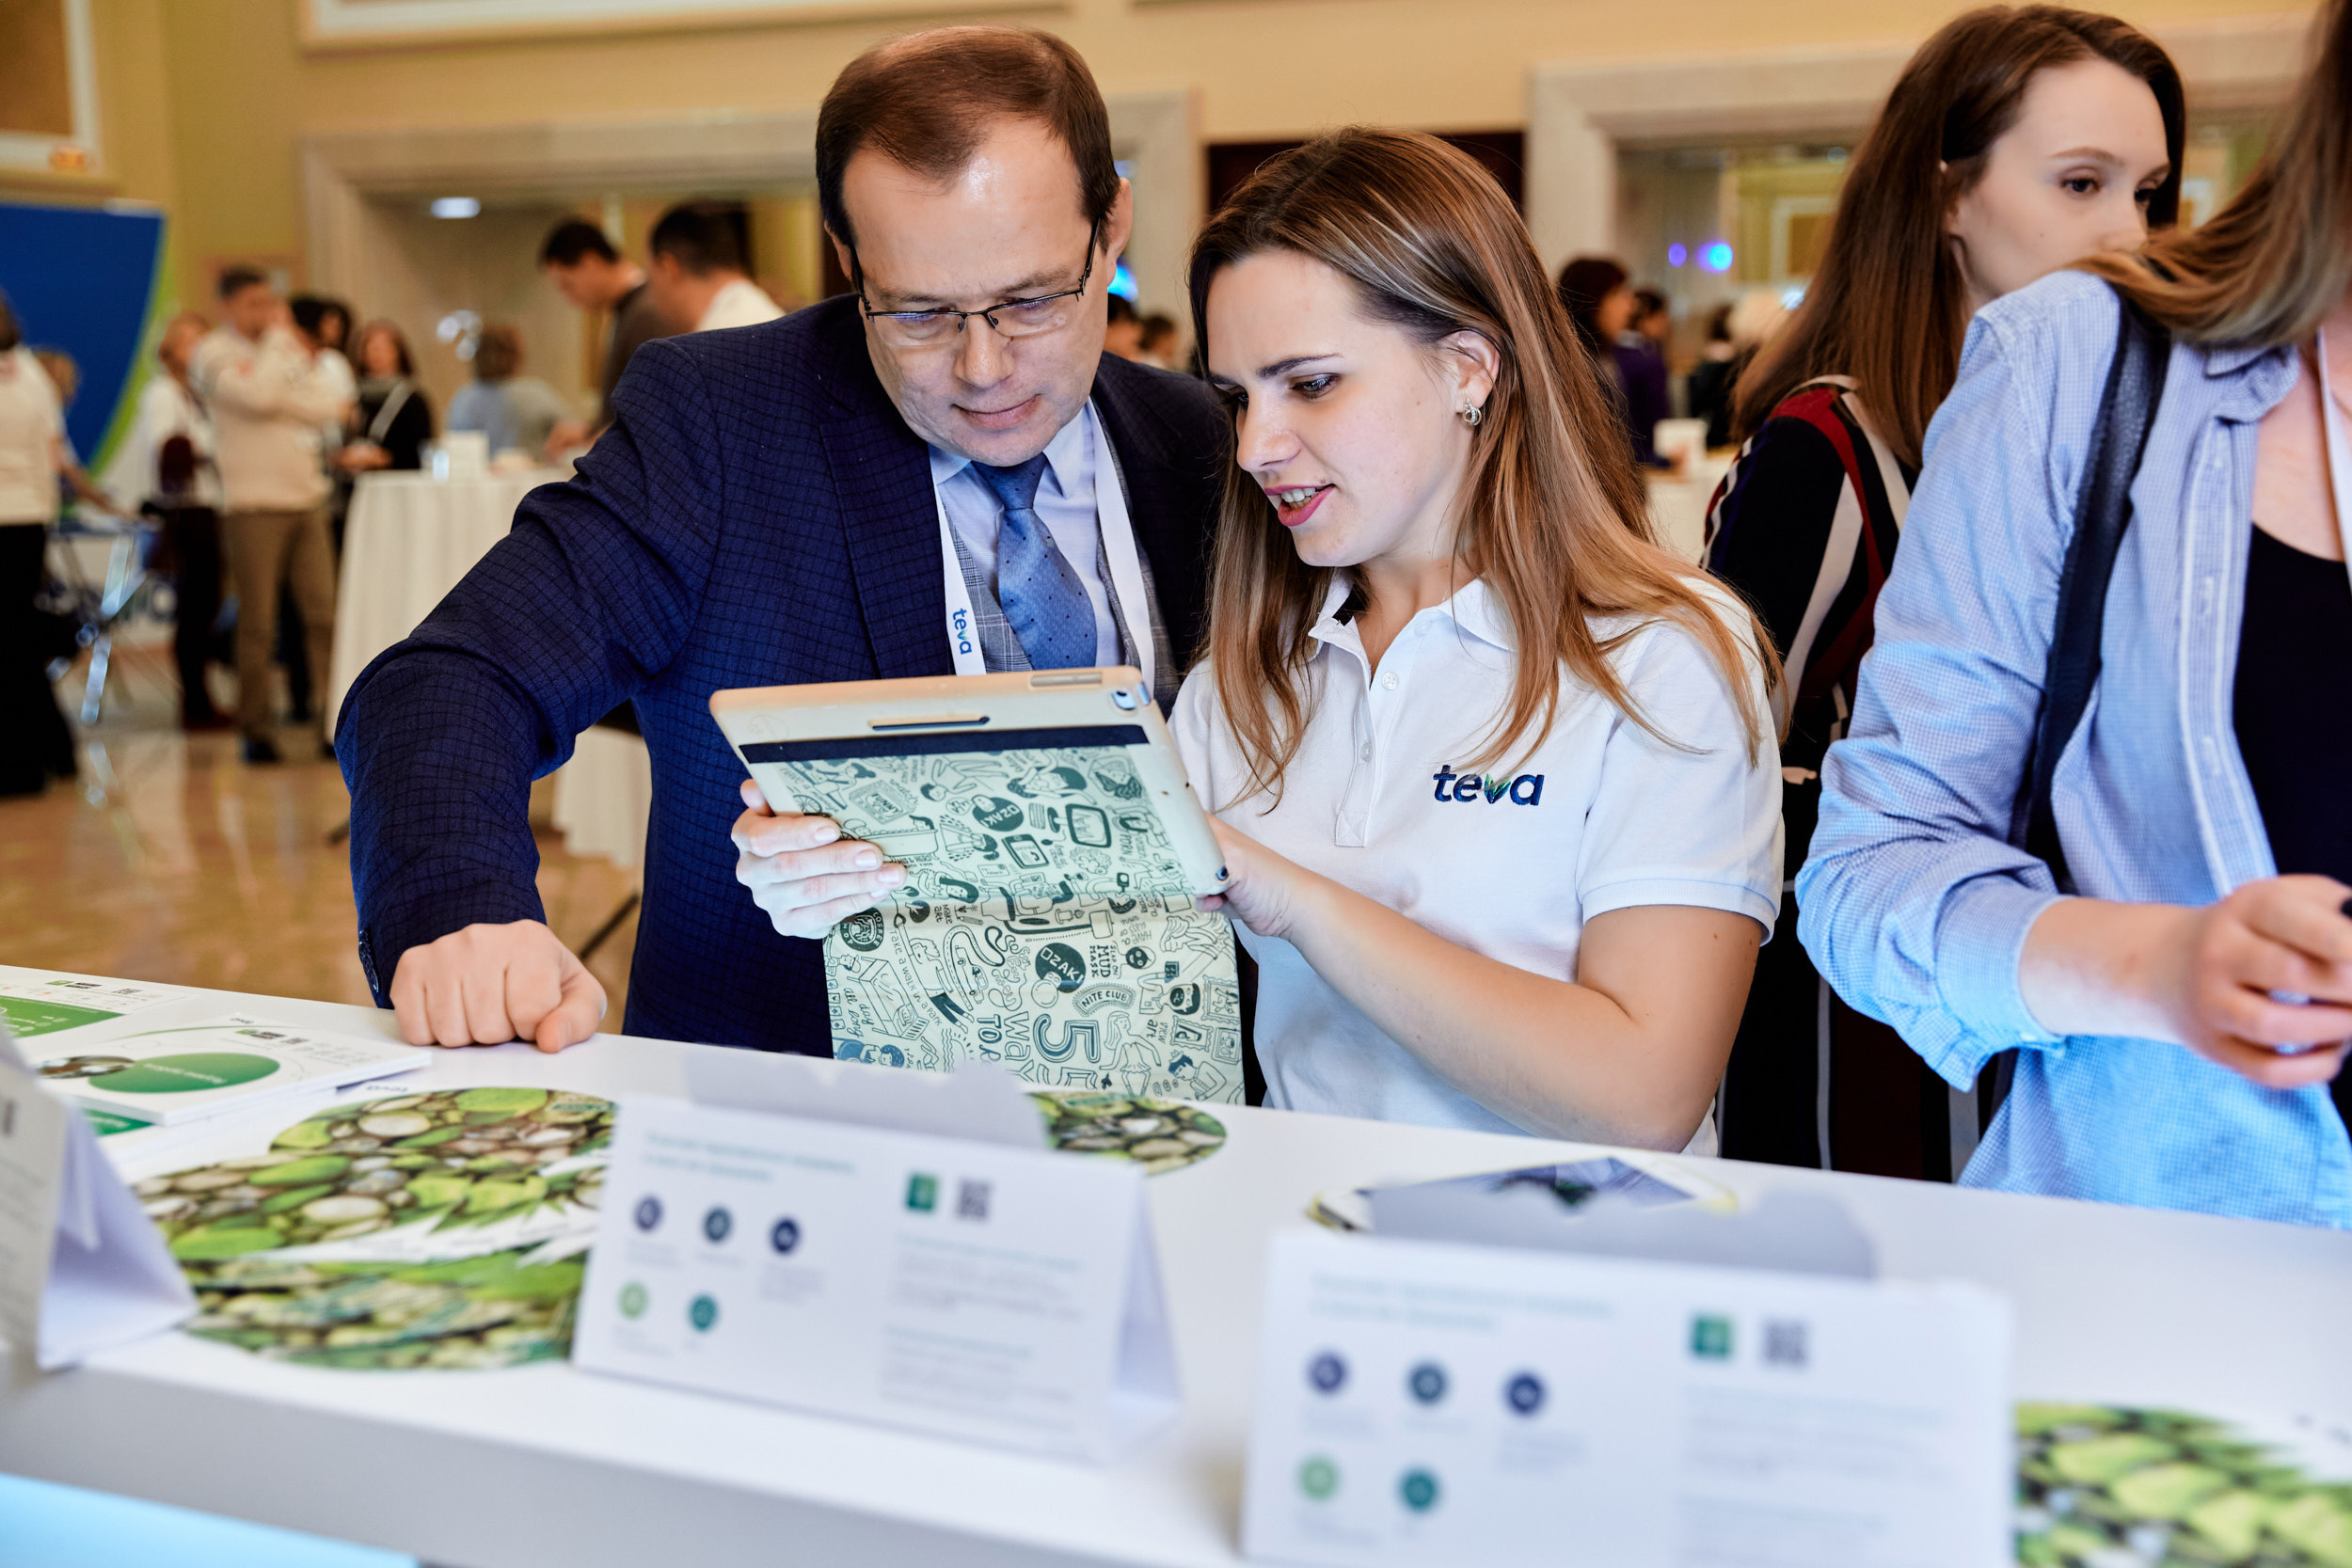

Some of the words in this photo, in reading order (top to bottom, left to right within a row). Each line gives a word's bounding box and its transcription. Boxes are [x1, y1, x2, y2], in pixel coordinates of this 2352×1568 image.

[952, 608, 973, 655] teva
[1433, 765, 1545, 805] teva
[980, 804, 1021, 829] OZAKI
[1040, 946, 1085, 985] OZAKI
[1089, 945, 1099, 977] MASK
[1096, 945, 1111, 977] MUD
[1109, 945, 1118, 962] SLAP
[1111, 964, 1119, 975] ON
[1081, 990, 1103, 1007] NITE
[1105, 990, 1128, 1002] CLUB
[1146, 1019, 1158, 1038] art
